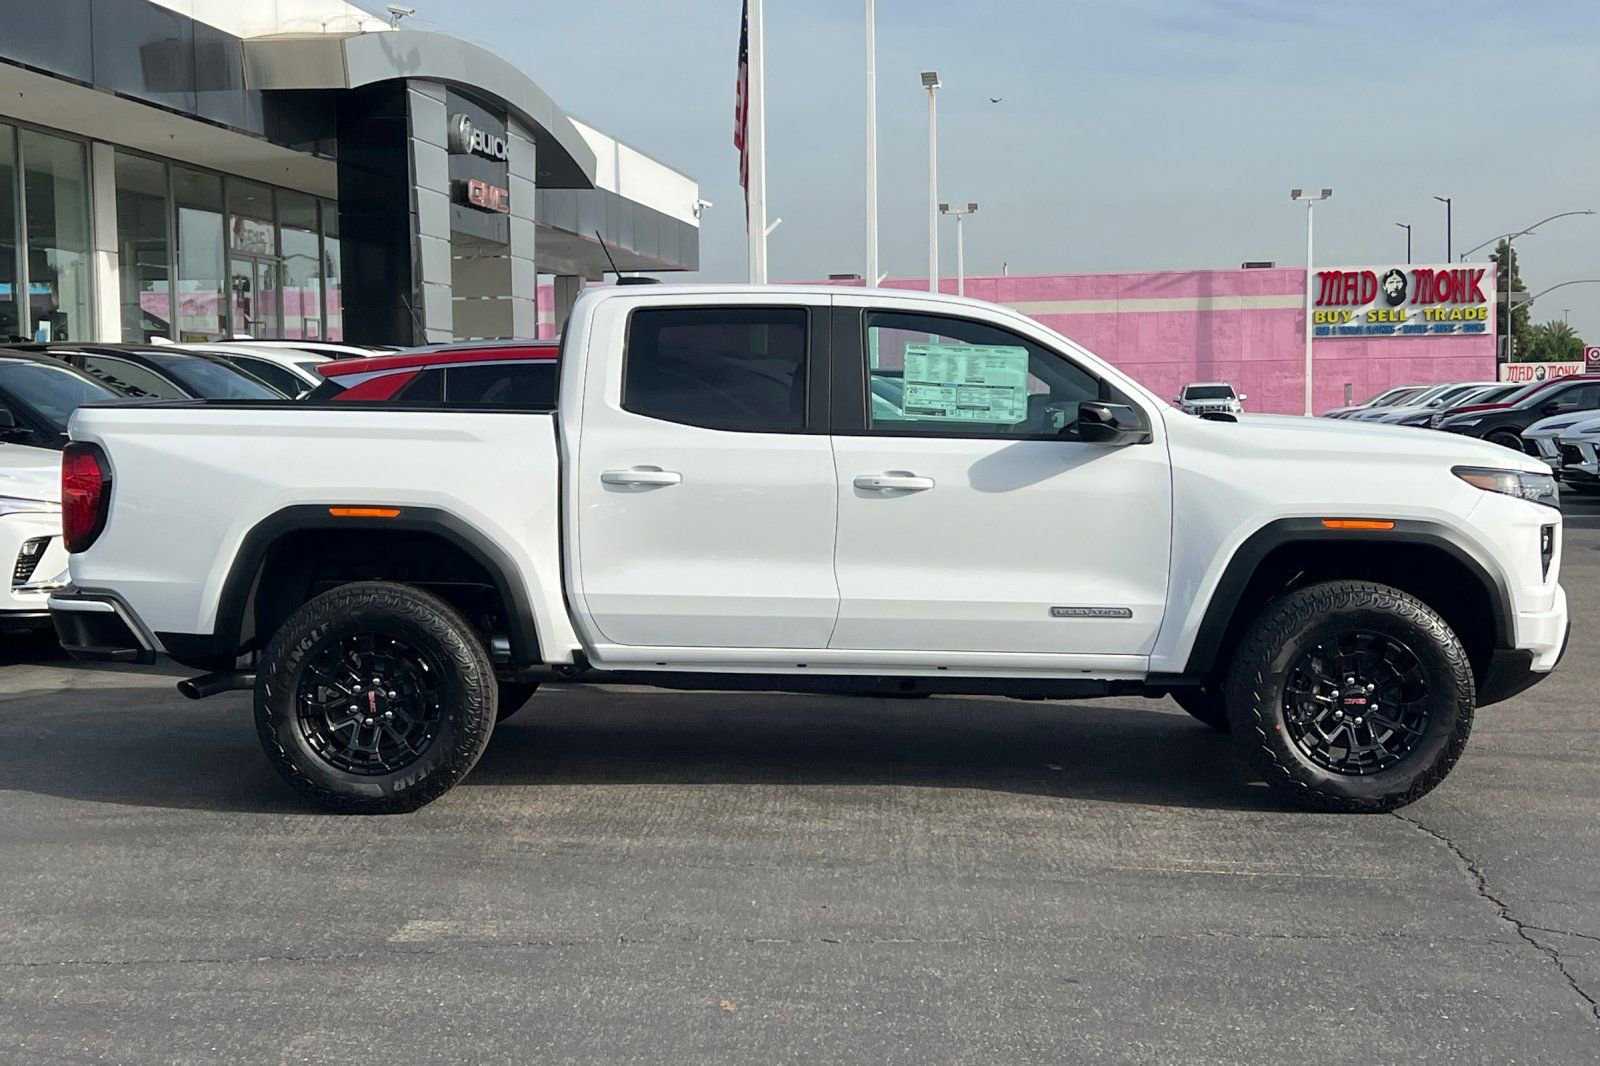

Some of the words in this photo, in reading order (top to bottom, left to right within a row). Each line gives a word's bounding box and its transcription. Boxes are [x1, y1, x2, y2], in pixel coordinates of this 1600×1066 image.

[472, 128, 511, 161] BUICK
[468, 178, 509, 213] GMC
[1315, 270, 1378, 306] MAD
[1411, 268, 1487, 304] MONK
[1314, 310, 1352, 324] BUY
[1367, 309, 1408, 323] SELL
[1424, 307, 1488, 321] TRADE
[1506, 366, 1533, 381] MAD
[1547, 366, 1579, 379] MONK
